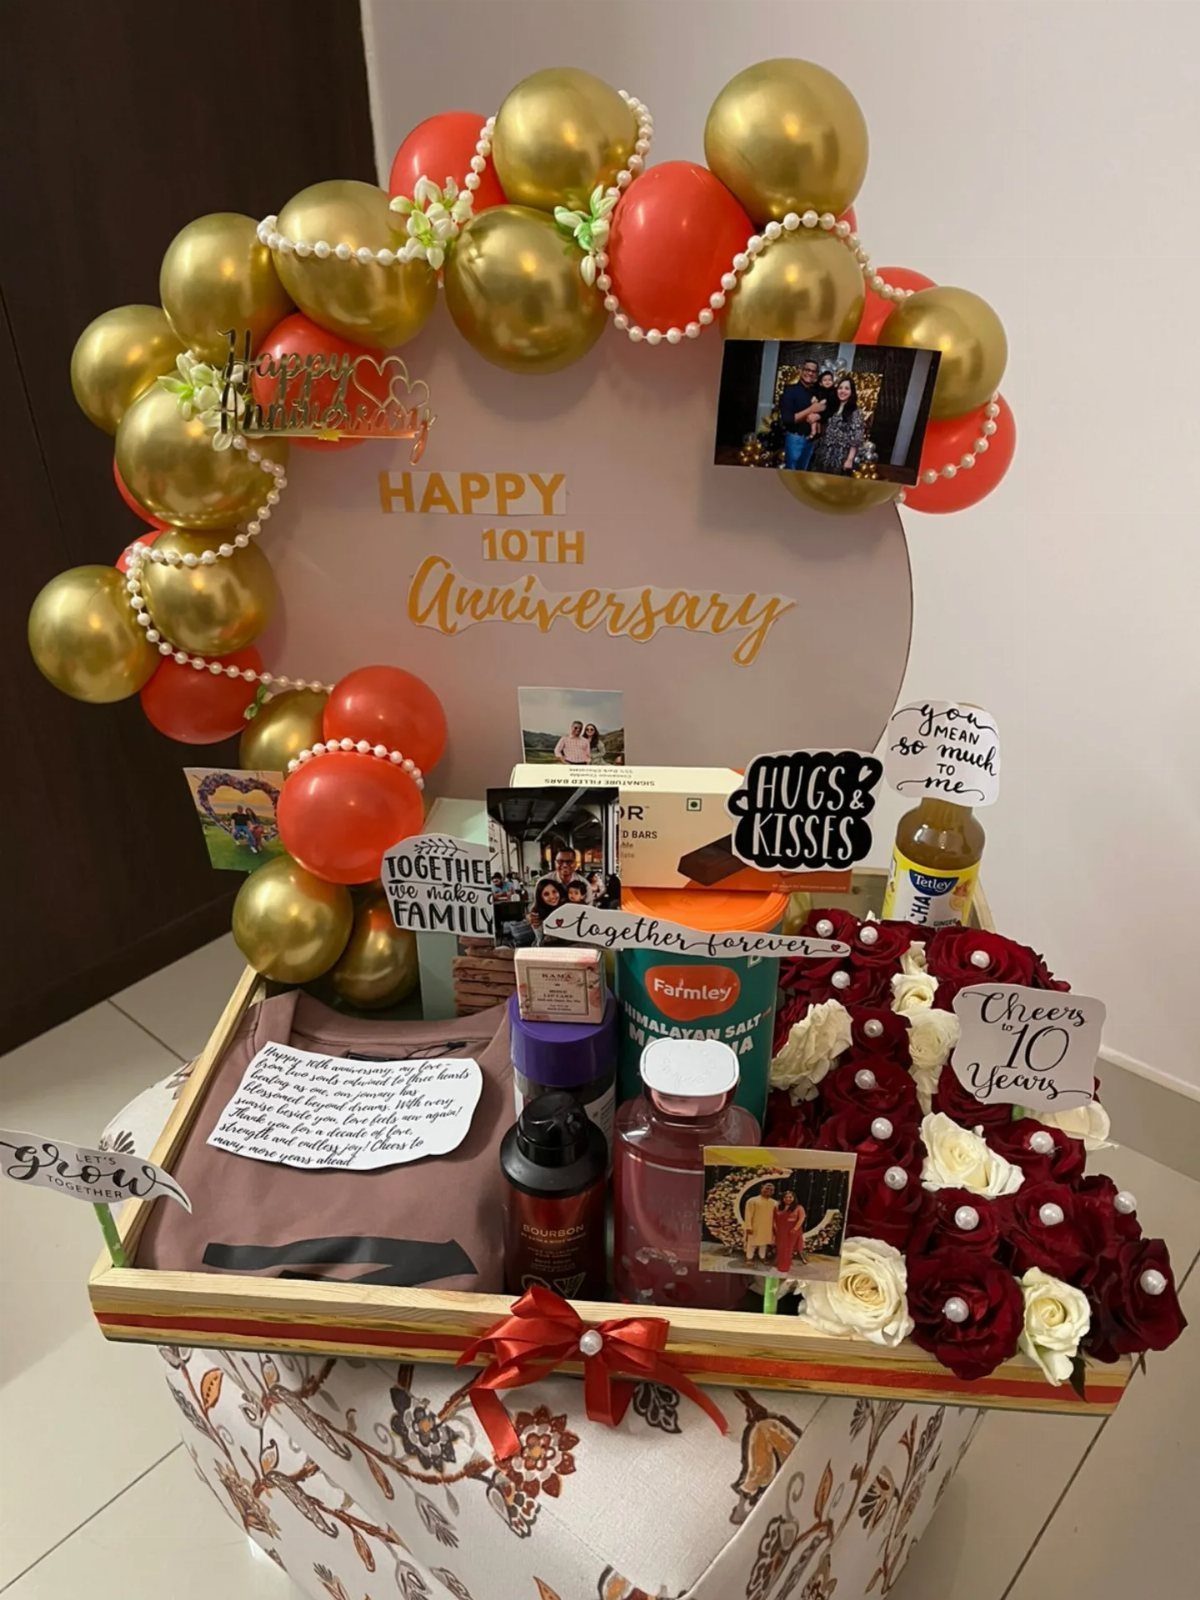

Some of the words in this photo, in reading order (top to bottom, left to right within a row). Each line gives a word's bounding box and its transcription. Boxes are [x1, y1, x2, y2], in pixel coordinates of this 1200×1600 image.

[217, 329, 354, 403] Happy
[378, 471, 566, 516] HAPPY
[482, 529, 585, 564] 10TH
[408, 555, 797, 666] Anniversary
[892, 704, 998, 735] you
[934, 725, 980, 745] MEAN
[891, 737, 927, 756] so
[937, 745, 996, 776] much
[937, 763, 955, 776] TO
[757, 765, 845, 811] HUGS
[849, 789, 865, 810] &
[897, 777, 985, 801] me
[631, 830, 658, 840] BARS
[752, 813, 854, 860] KISSES
[389, 885, 418, 899] we
[427, 883, 479, 904] make
[914, 873, 951, 894] Tetley
[567, 911, 690, 950] together
[702, 933, 814, 957] forever
[654, 978, 731, 1002] Farmley
[624, 1002, 720, 1040] HIMALAYAN
[725, 1013, 762, 1039] SALT
[962, 992, 1086, 1027] Cheers
[1002, 1022, 1014, 1032] to
[264, 1047, 301, 1067] Happy
[306, 1059, 333, 1070] 10th
[399, 1066, 415, 1076] my
[419, 1061, 441, 1073] love
[1000, 1023, 1070, 1072] 10
[250, 1069, 290, 1091] beating
[293, 1084, 307, 1093] as
[333, 1091, 352, 1099] our
[349, 1091, 395, 1102] journey
[399, 1084, 417, 1096] has
[255, 1058, 283, 1073] from
[285, 1064, 308, 1078] two
[310, 1074, 340, 1086] souls
[343, 1077, 392, 1087] entwined
[391, 1075, 405, 1086] to
[406, 1070, 434, 1085] three
[436, 1068, 470, 1081] hearts
[967, 1063, 1090, 1100] Years
[235, 1097, 274, 1112] sunrise
[276, 1104, 312, 1120] beside
[343, 1113, 368, 1126] love
[369, 1112, 399, 1126] feels
[425, 1106, 463, 1123] again!
[243, 1081, 304, 1106] blossomed
[304, 1096, 347, 1113] beyond
[395, 1094, 425, 1109] With
[424, 1099, 454, 1109] every
[219, 1121, 272, 1141] strength
[271, 1136, 298, 1147] and
[298, 1138, 341, 1154] endless
[337, 1140, 371, 1158] joy!
[370, 1138, 406, 1152] Cheers
[410, 1136, 424, 1150] to
[228, 1107, 267, 1124] Thank
[267, 1121, 291, 1132] you
[291, 1123, 312, 1136] for
[327, 1127, 367, 1138] decade
[370, 1126, 386, 1140] of
[75, 1153, 117, 1166] LET'S
[213, 1136, 244, 1152] many
[249, 1145, 278, 1158] more
[279, 1153, 313, 1165] years
[5, 1142, 168, 1197] grow
[47, 1174, 122, 1199] TOGETHER
[523, 1223, 584, 1237] BOURBON
